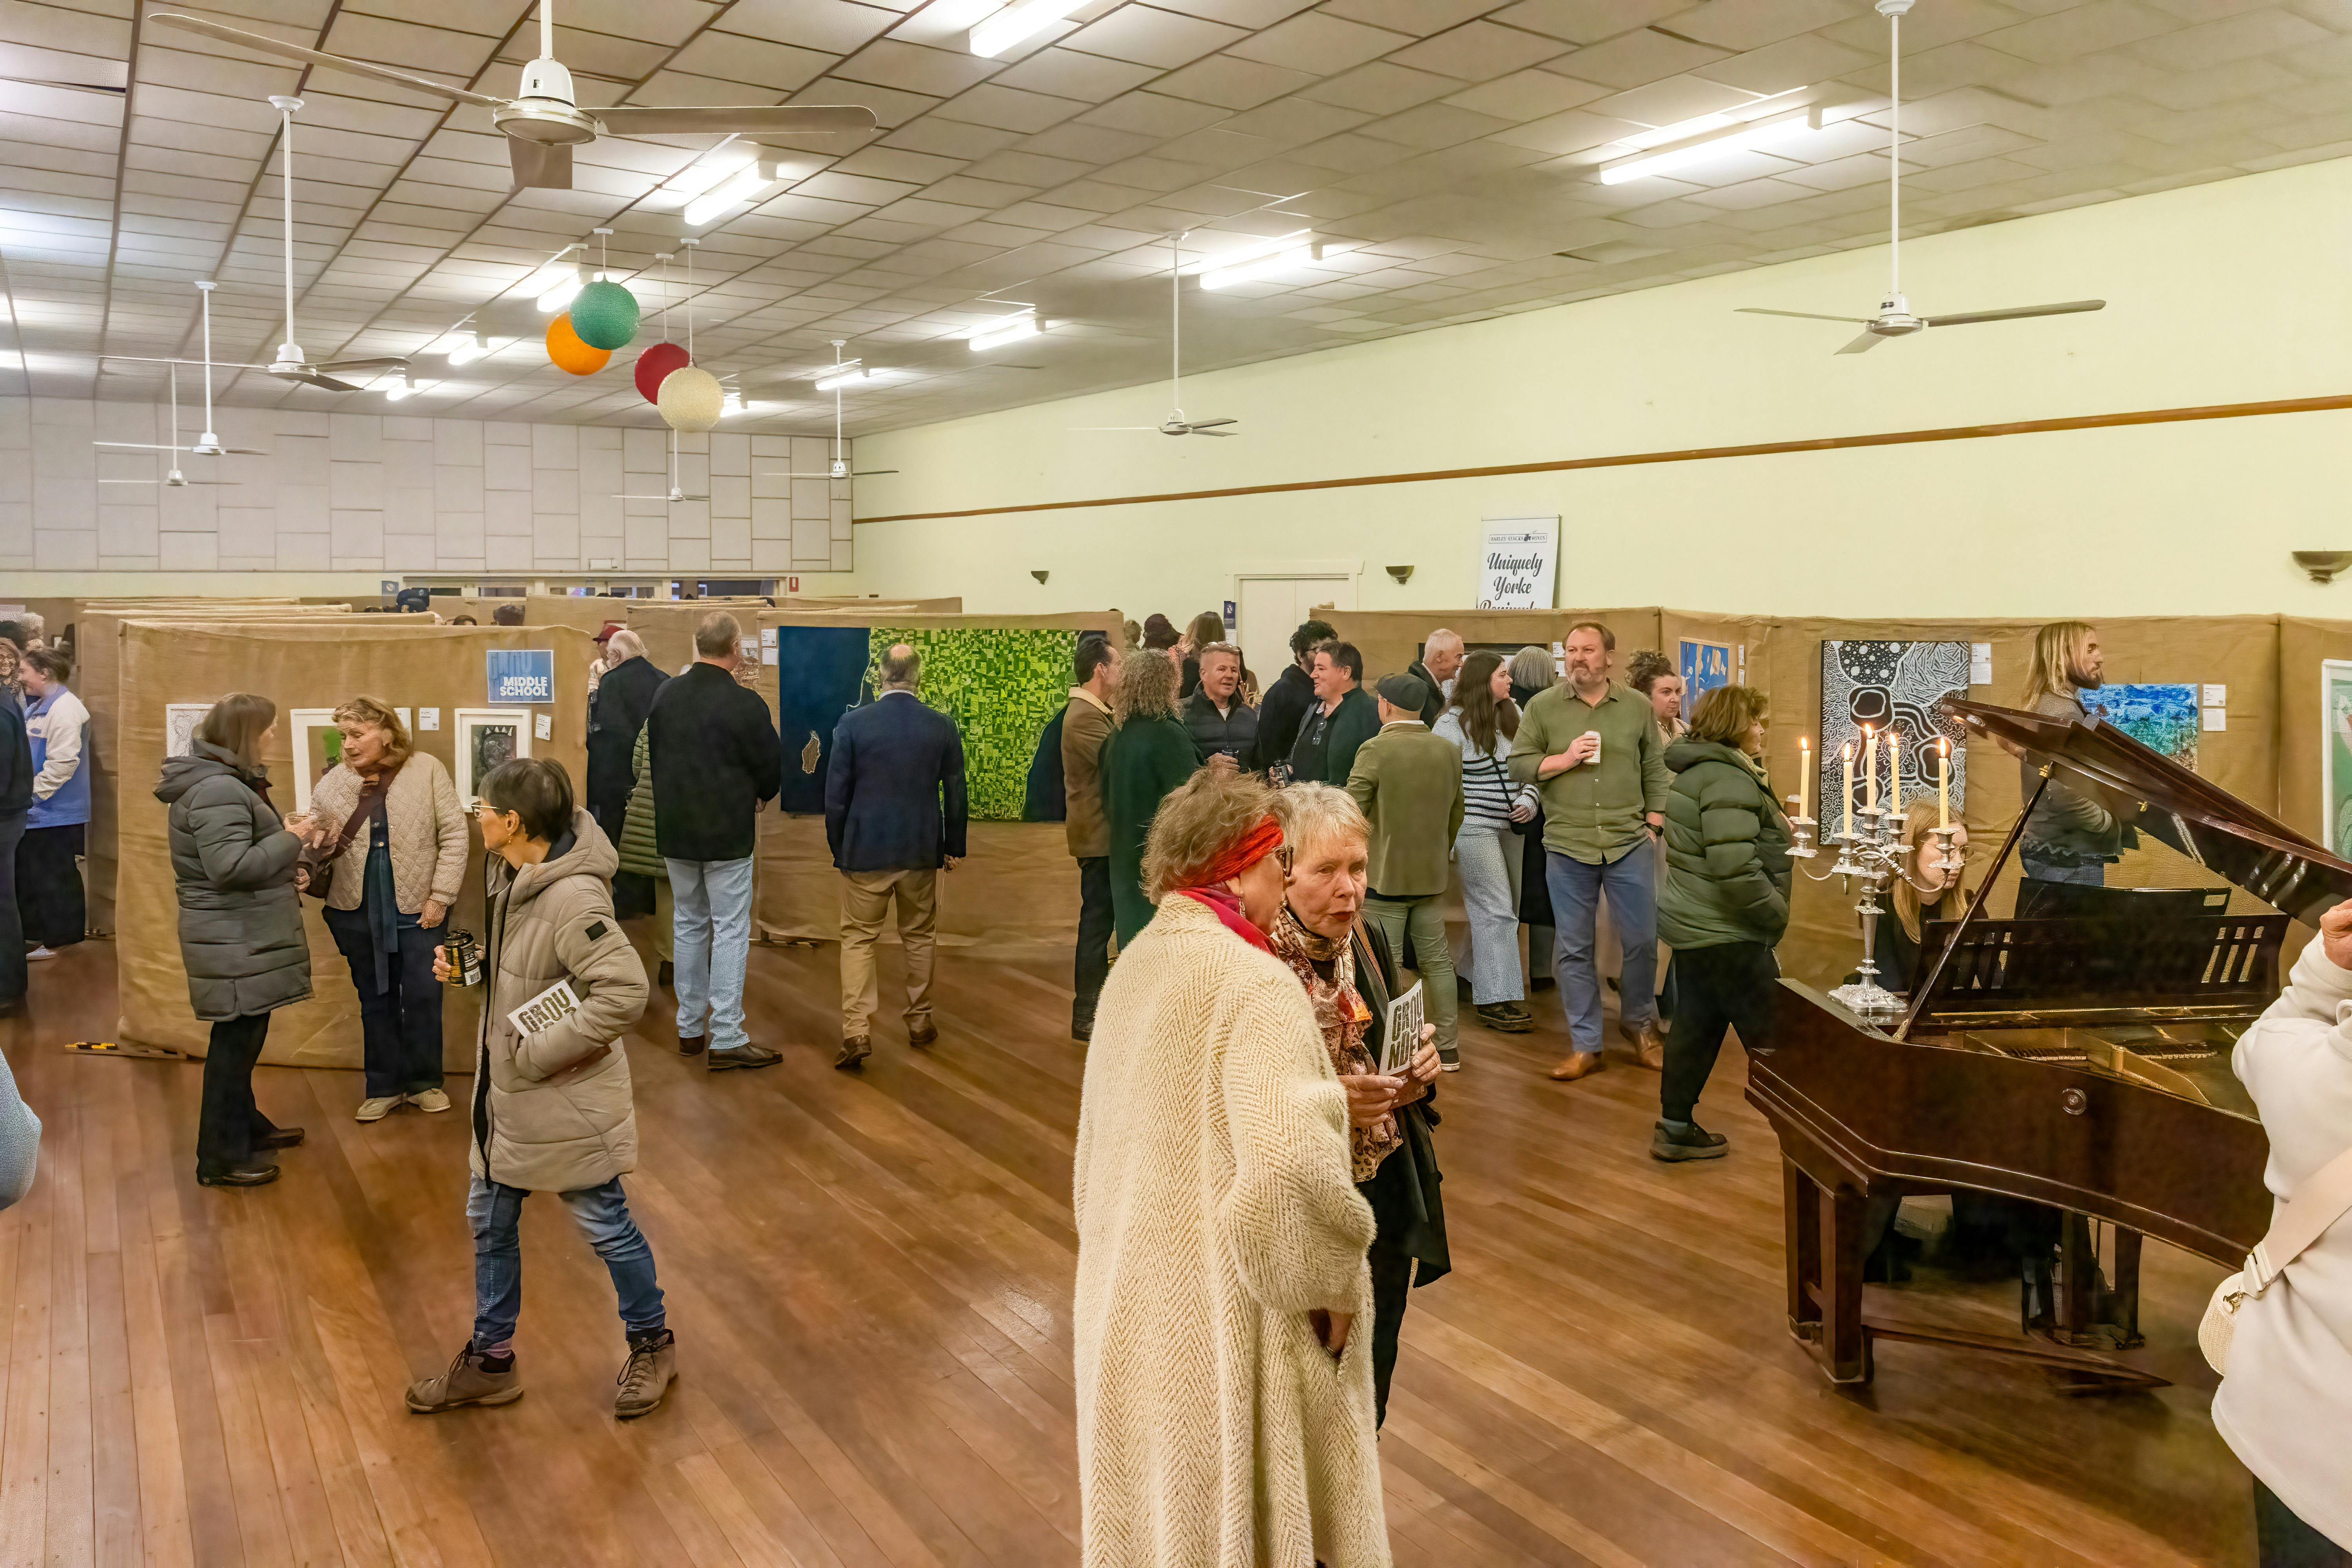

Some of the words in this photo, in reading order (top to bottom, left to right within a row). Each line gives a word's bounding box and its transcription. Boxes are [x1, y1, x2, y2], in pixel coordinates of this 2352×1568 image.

[1487, 552, 1543, 577] Uniquely
[1494, 576, 1532, 601] Yorke
[500, 686, 548, 696] SCHOOL
[503, 676, 548, 686] MIDDLE
[518, 987, 570, 1033] GROU
[1392, 989, 1421, 1042] GROU
